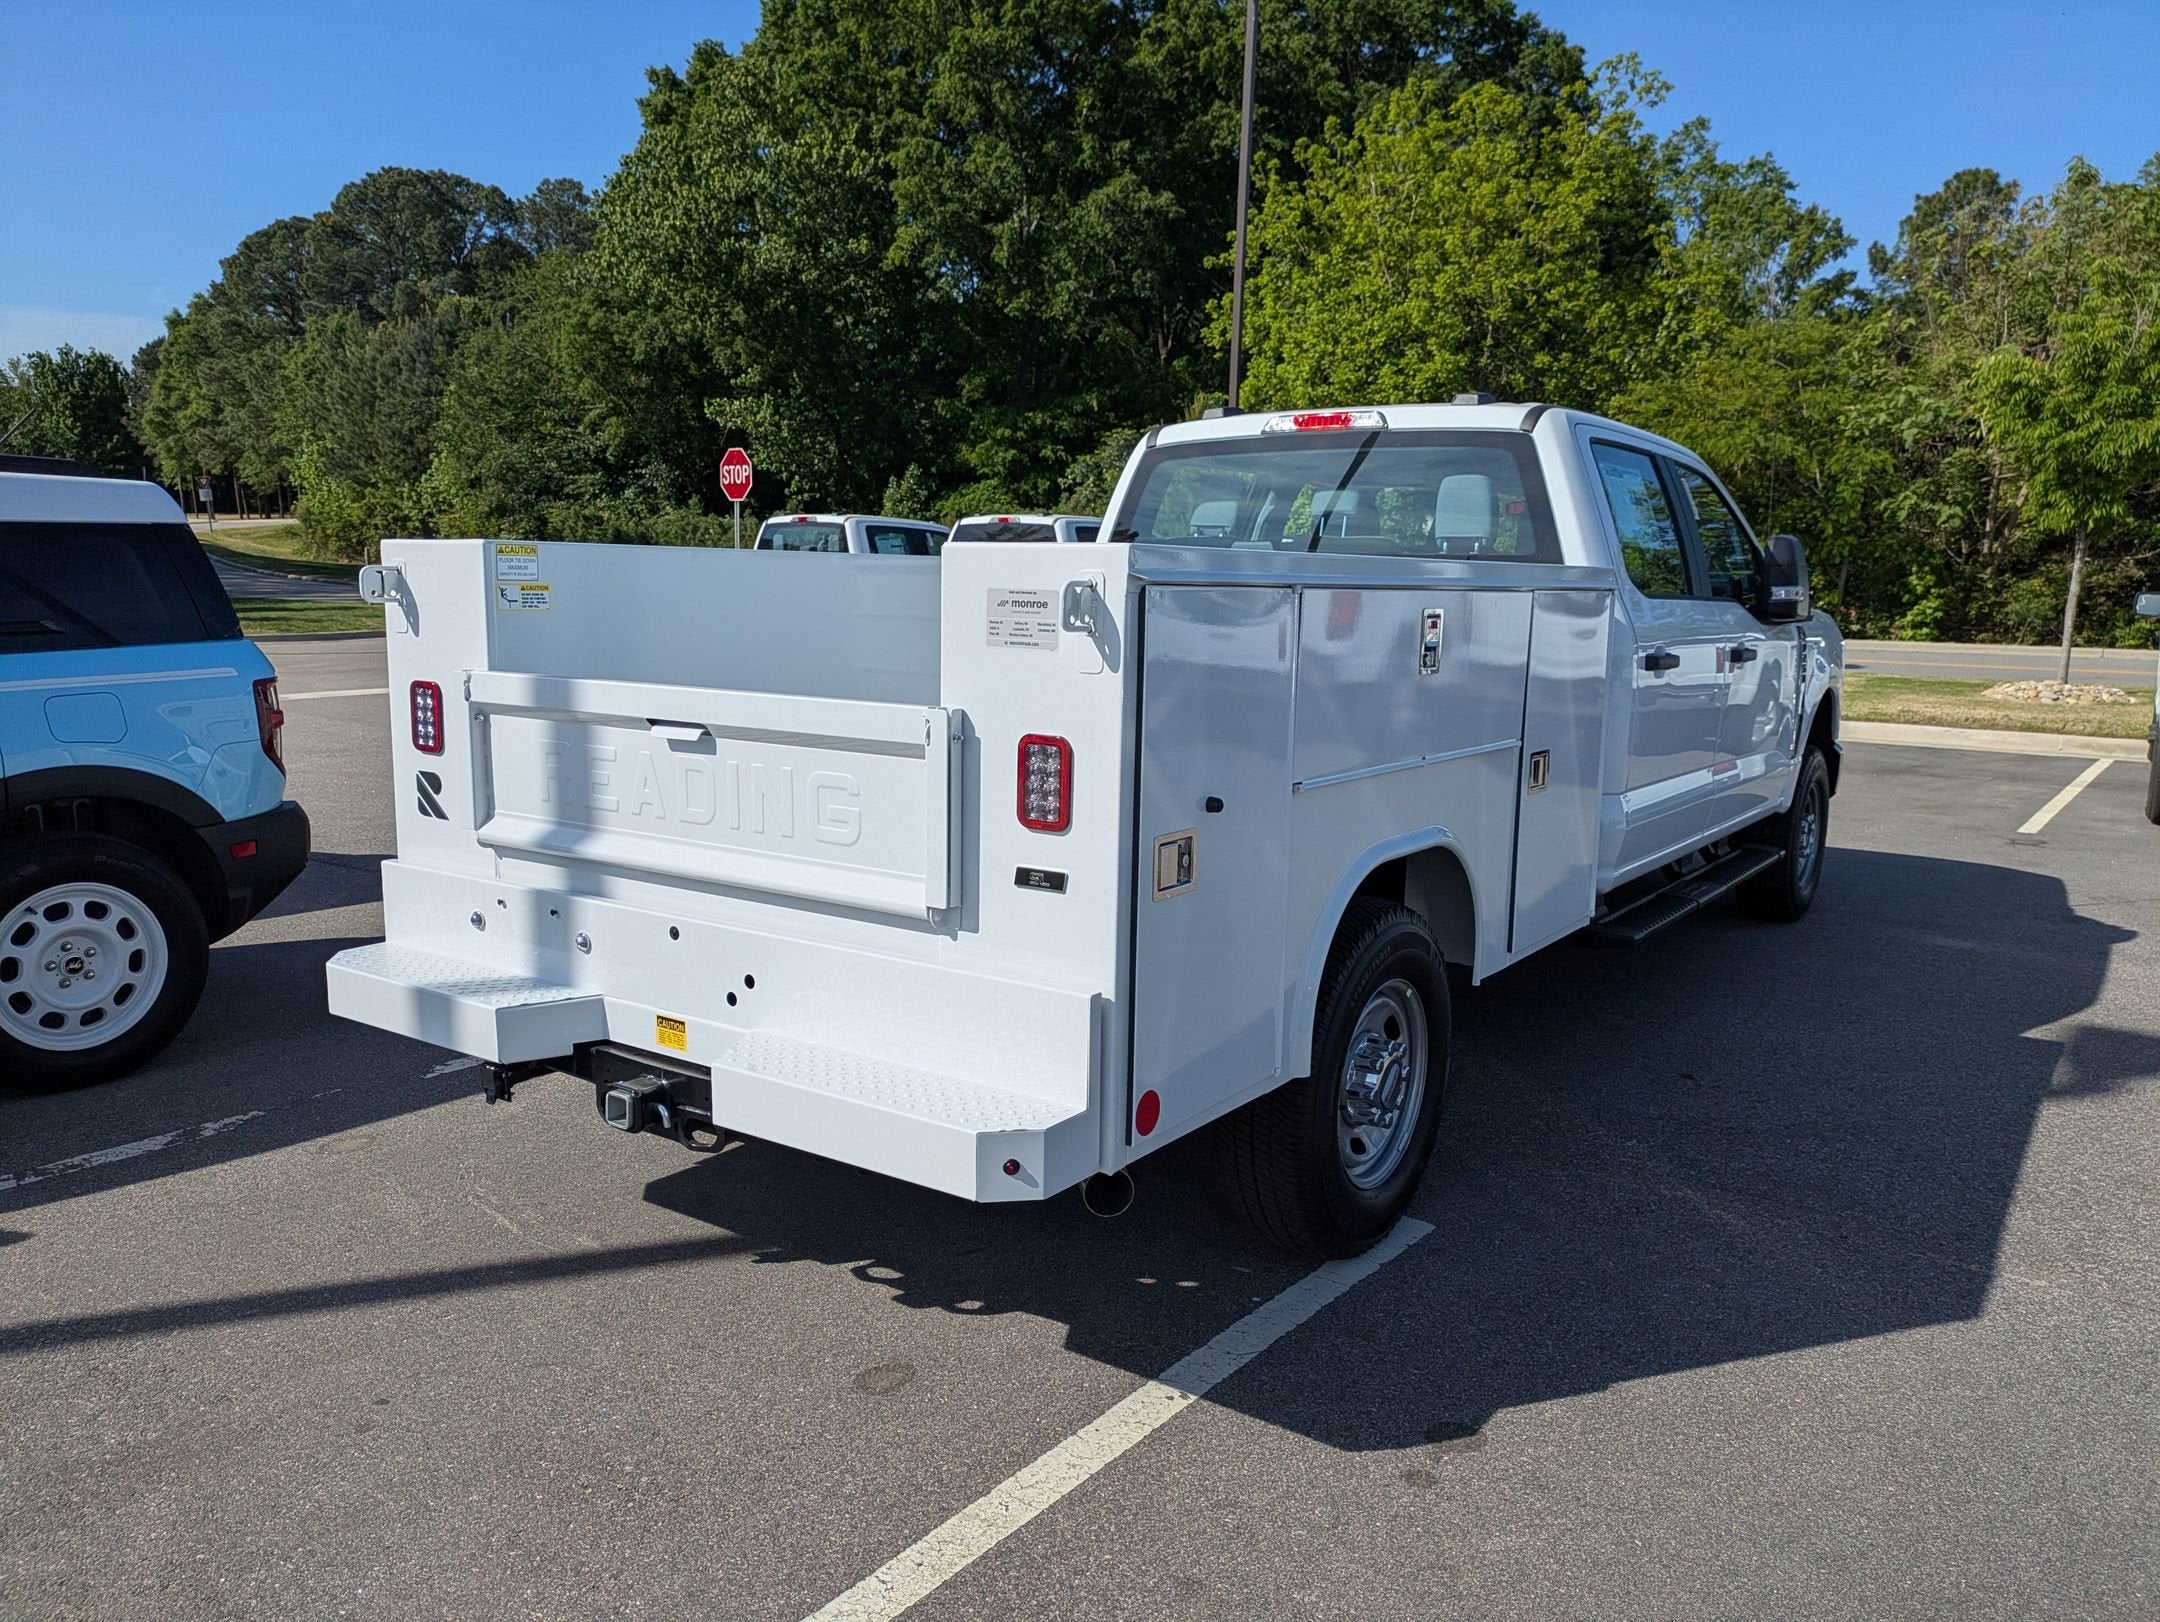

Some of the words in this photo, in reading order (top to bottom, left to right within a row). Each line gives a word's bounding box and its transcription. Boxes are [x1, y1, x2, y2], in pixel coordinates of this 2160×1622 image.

[723, 465, 749, 484] STOP
[504, 546, 536, 554] CAUTION
[1011, 600, 1048, 609] monroe
[537, 738, 863, 847] READING
[657, 1018, 685, 1032] CAUTION
